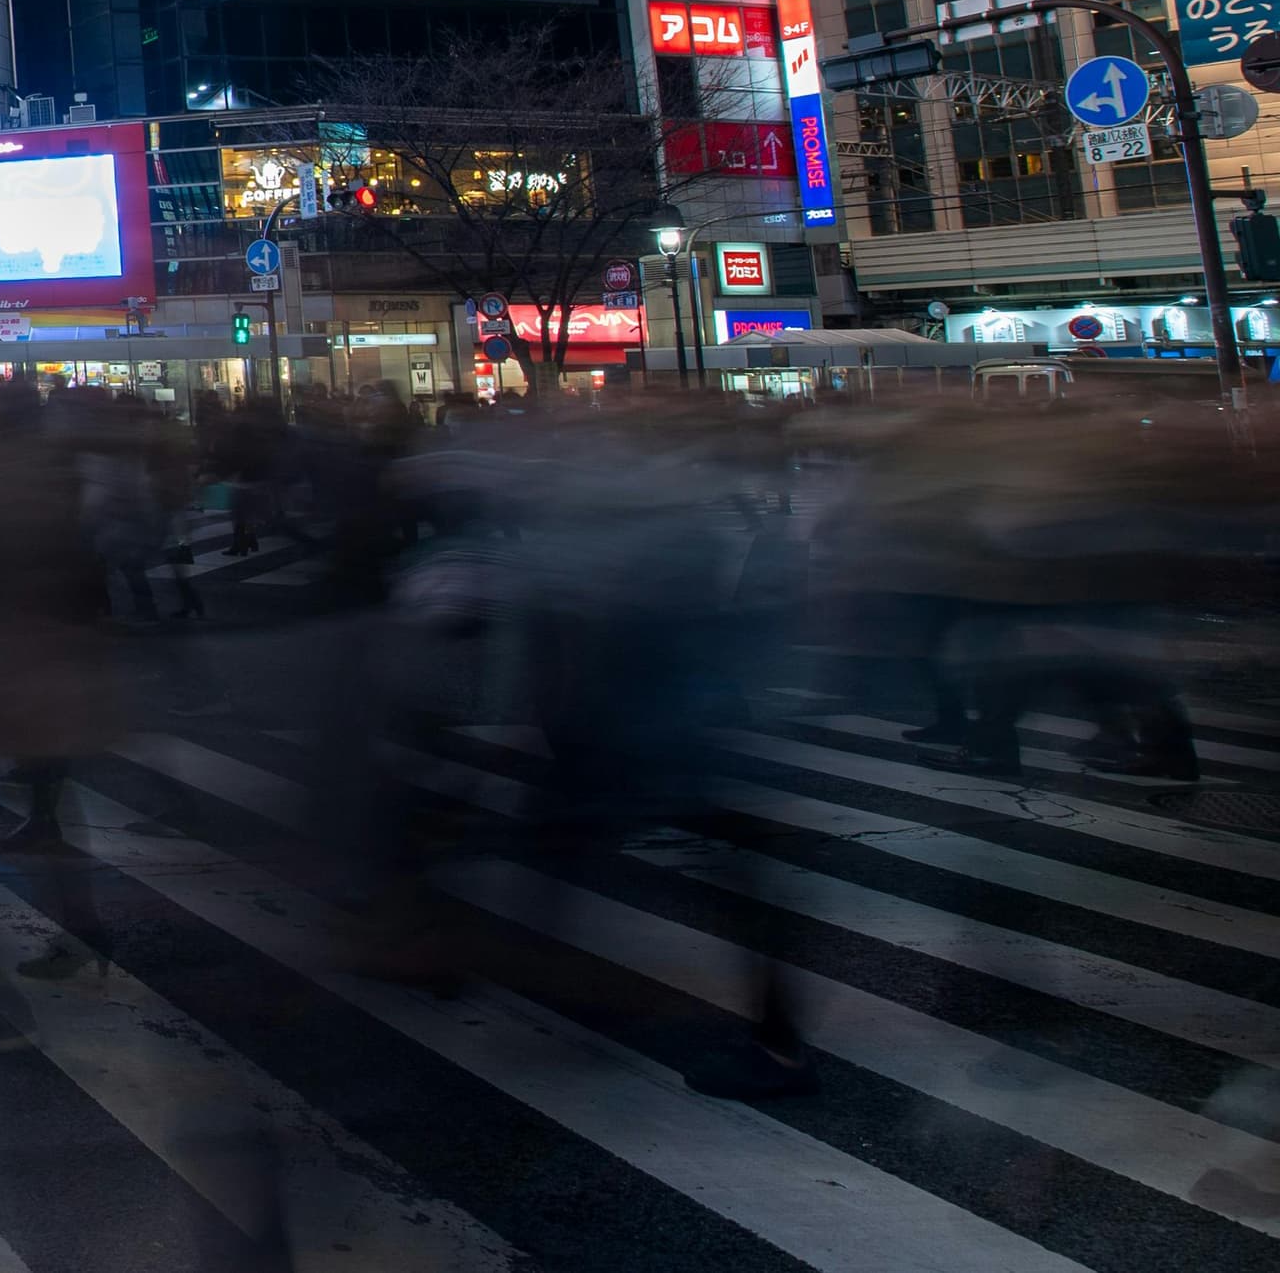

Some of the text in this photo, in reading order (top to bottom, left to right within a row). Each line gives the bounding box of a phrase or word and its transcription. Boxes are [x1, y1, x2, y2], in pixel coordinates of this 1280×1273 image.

[660, 14, 740, 44] アコム
[800, 116, 826, 190] PROMISE
[806, 208, 833, 220] プロミス
[728, 265, 760, 279] プロミス
